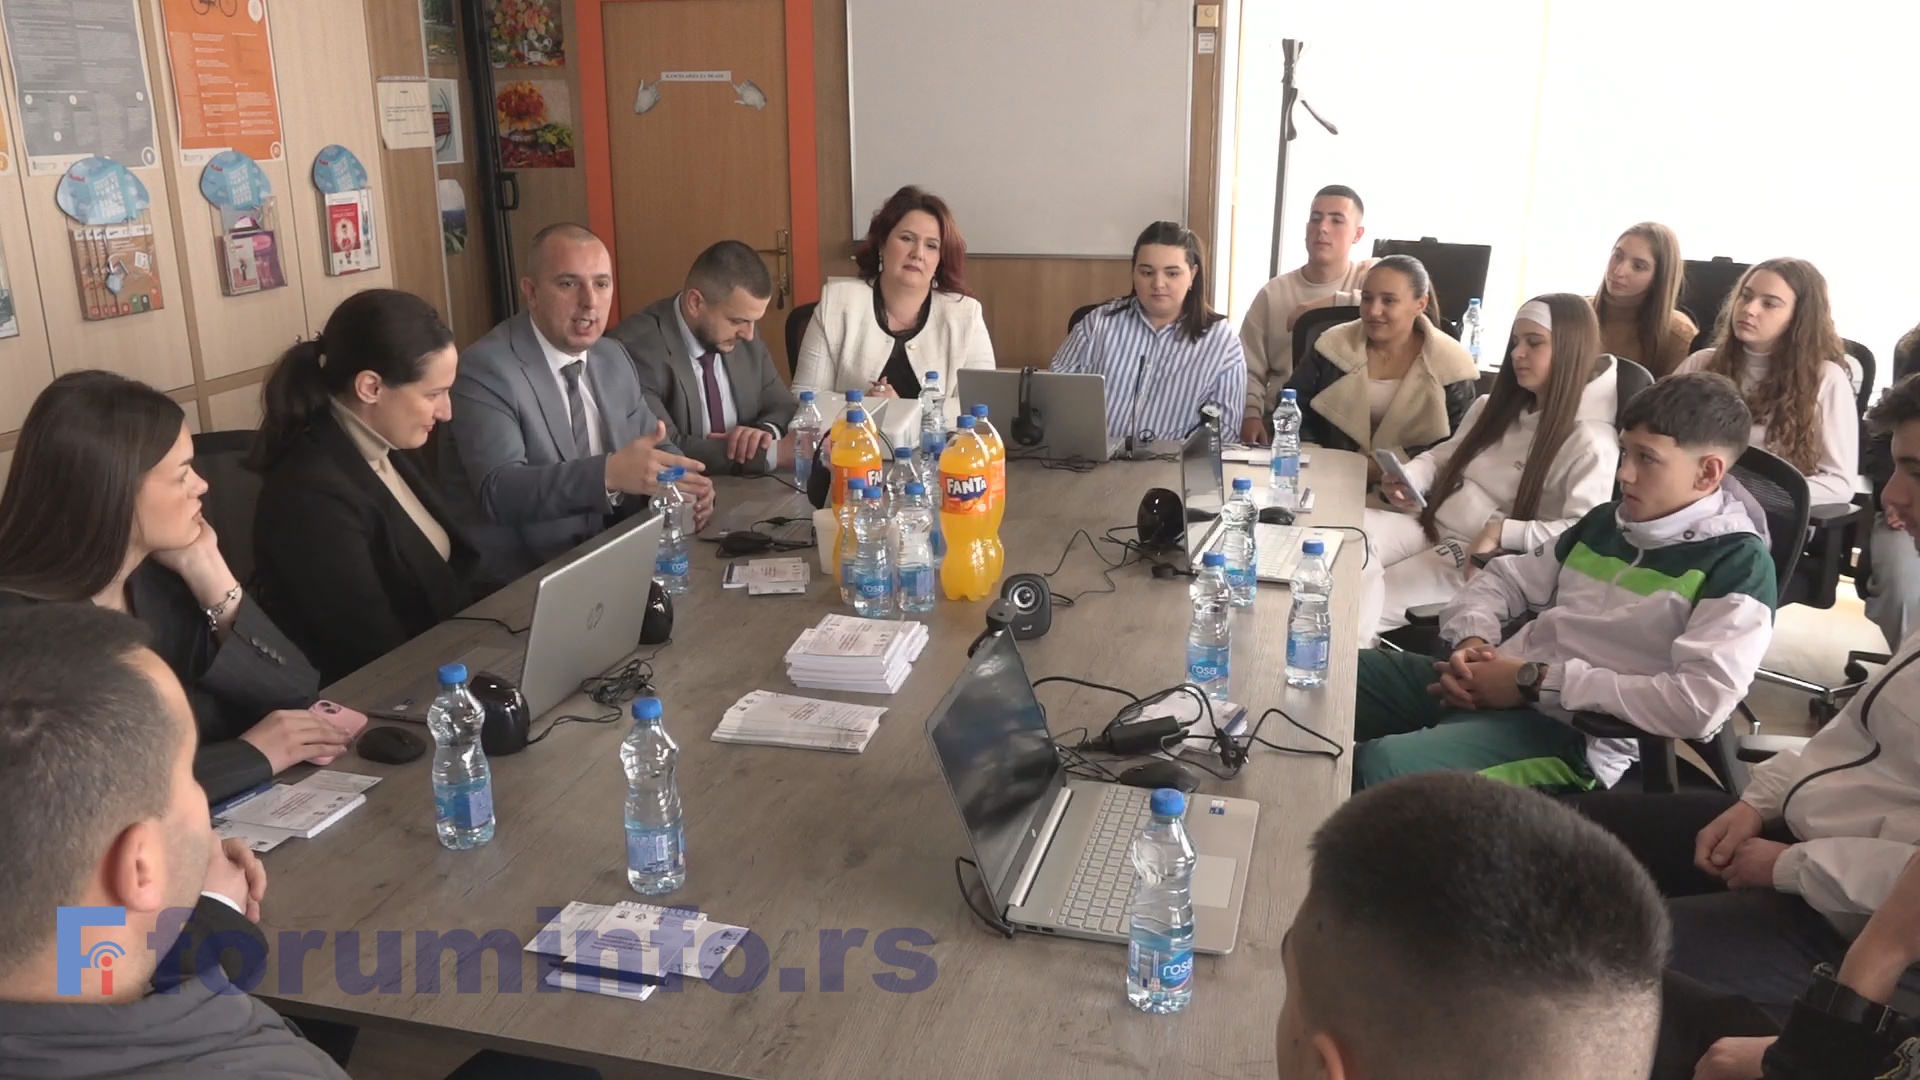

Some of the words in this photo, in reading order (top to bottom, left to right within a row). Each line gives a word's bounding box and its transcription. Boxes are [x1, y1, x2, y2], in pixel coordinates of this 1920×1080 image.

[946, 476, 988, 495] FANTA
[863, 585, 884, 593] rosa
[1191, 665, 1217, 676] rosa
